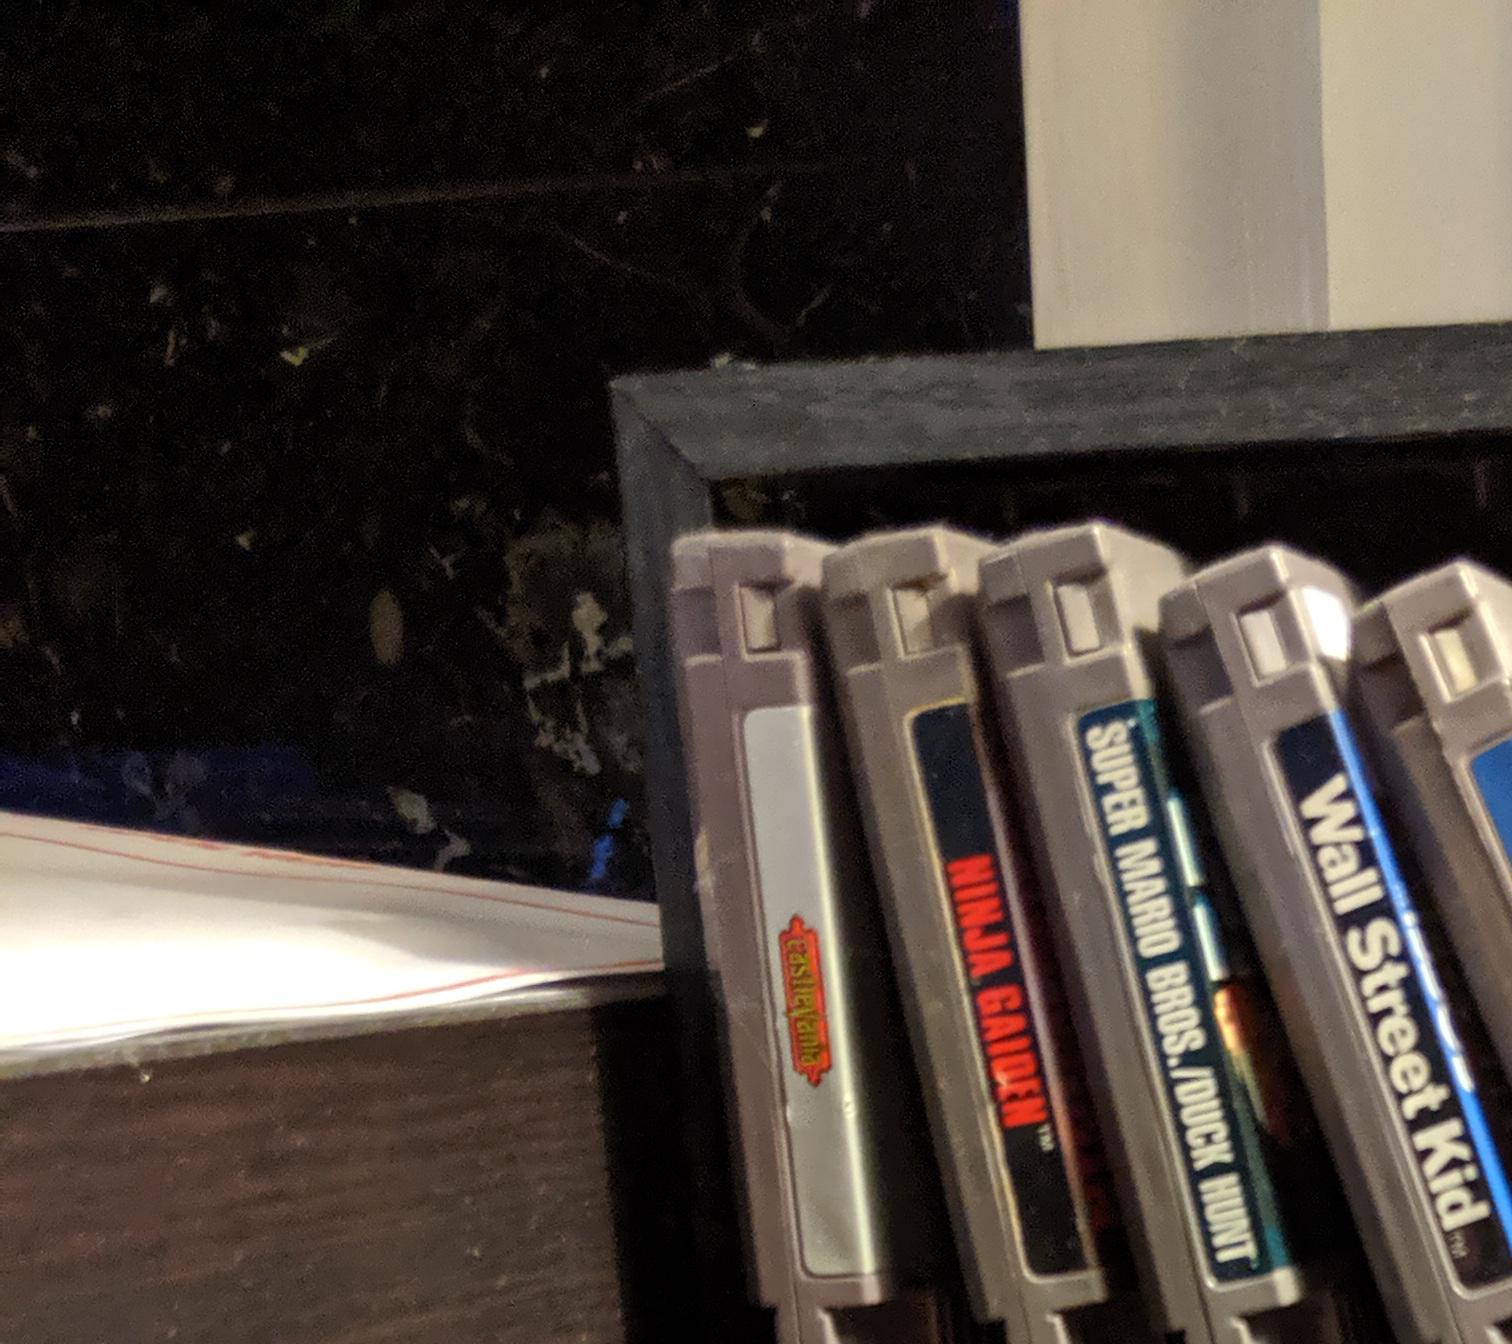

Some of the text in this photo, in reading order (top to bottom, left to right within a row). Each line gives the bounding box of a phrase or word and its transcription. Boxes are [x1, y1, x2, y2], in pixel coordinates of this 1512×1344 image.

[1085, 721, 1148, 833] SUPER
[947, 855, 1013, 979] NINJA
[1115, 839, 1181, 957] MARIO
[977, 984, 1047, 1128] GAIDEN
[1300, 774, 1385, 914] Wall
[1347, 917, 1451, 1121] Street
[1415, 1116, 1491, 1232] Kid
[1199, 1174, 1256, 1265] HUNT
